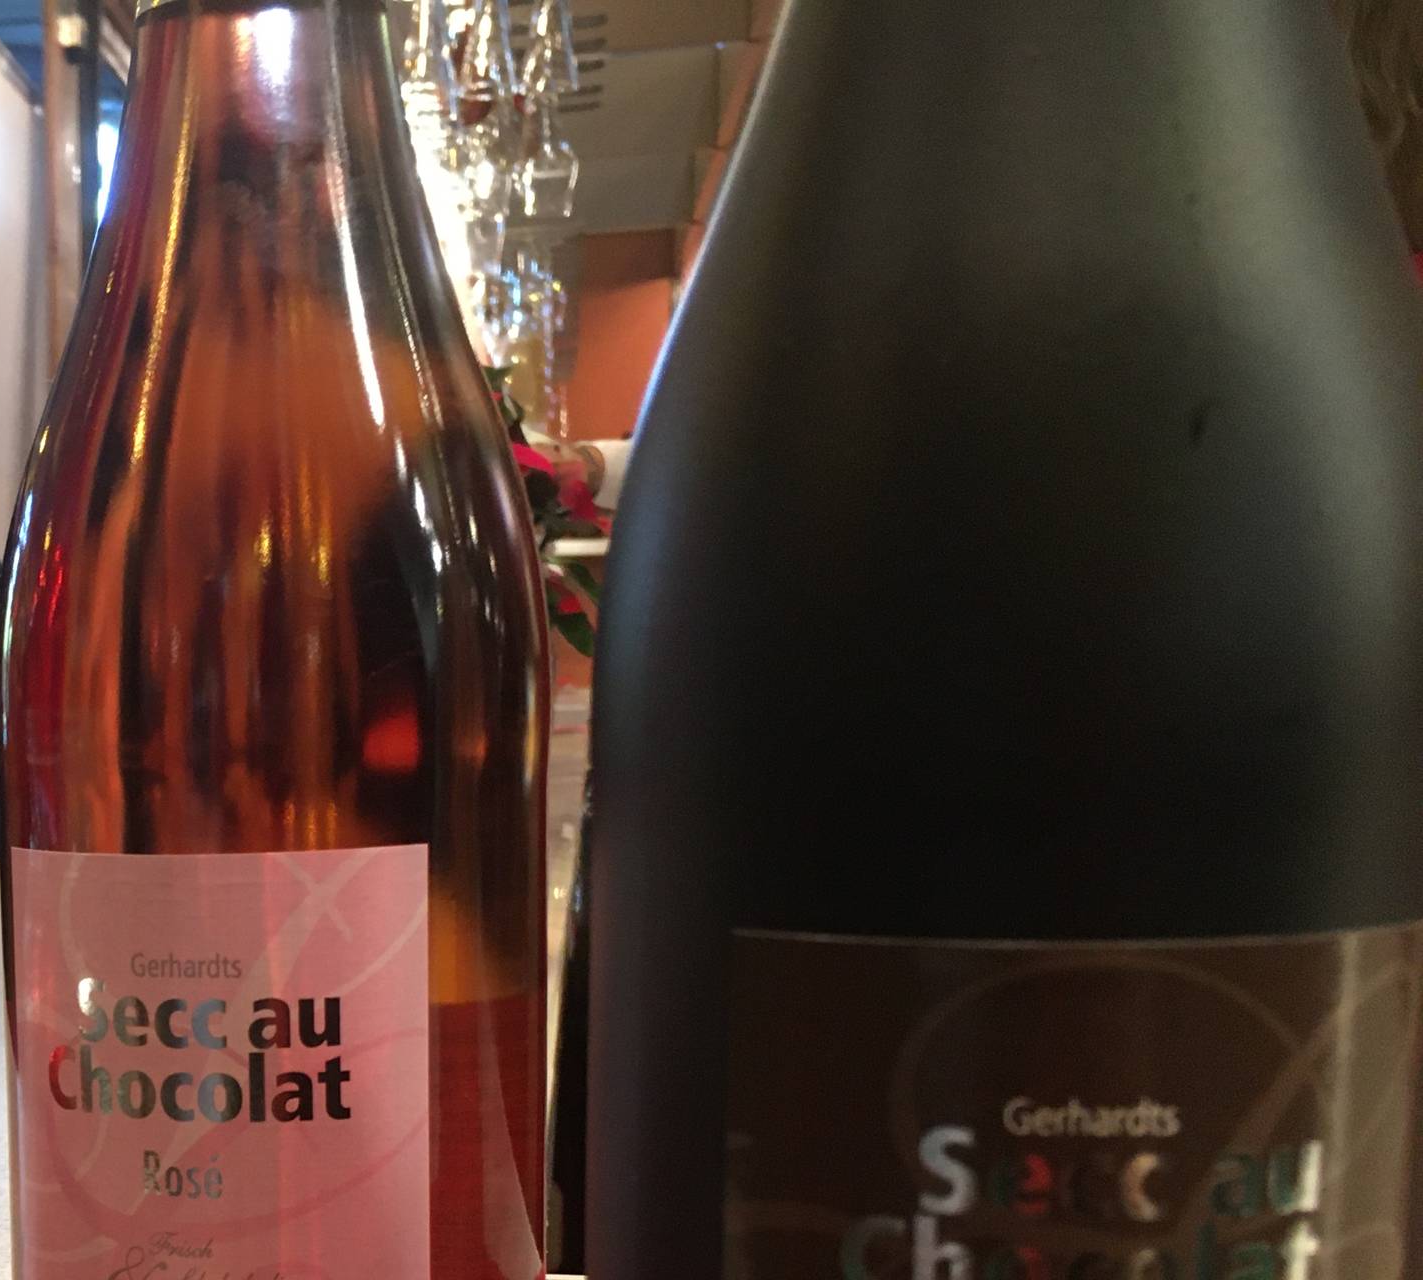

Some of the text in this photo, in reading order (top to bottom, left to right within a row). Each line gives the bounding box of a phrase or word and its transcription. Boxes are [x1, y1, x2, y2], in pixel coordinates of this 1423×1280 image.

[130, 952, 243, 979] Gerhardts
[78, 977, 342, 1050] Secc au
[48, 1043, 352, 1123] Chocolat
[1002, 1096, 1180, 1137] Gerhardts
[143, 1149, 224, 1200] Rosé
[1208, 1139, 1324, 1217] au
